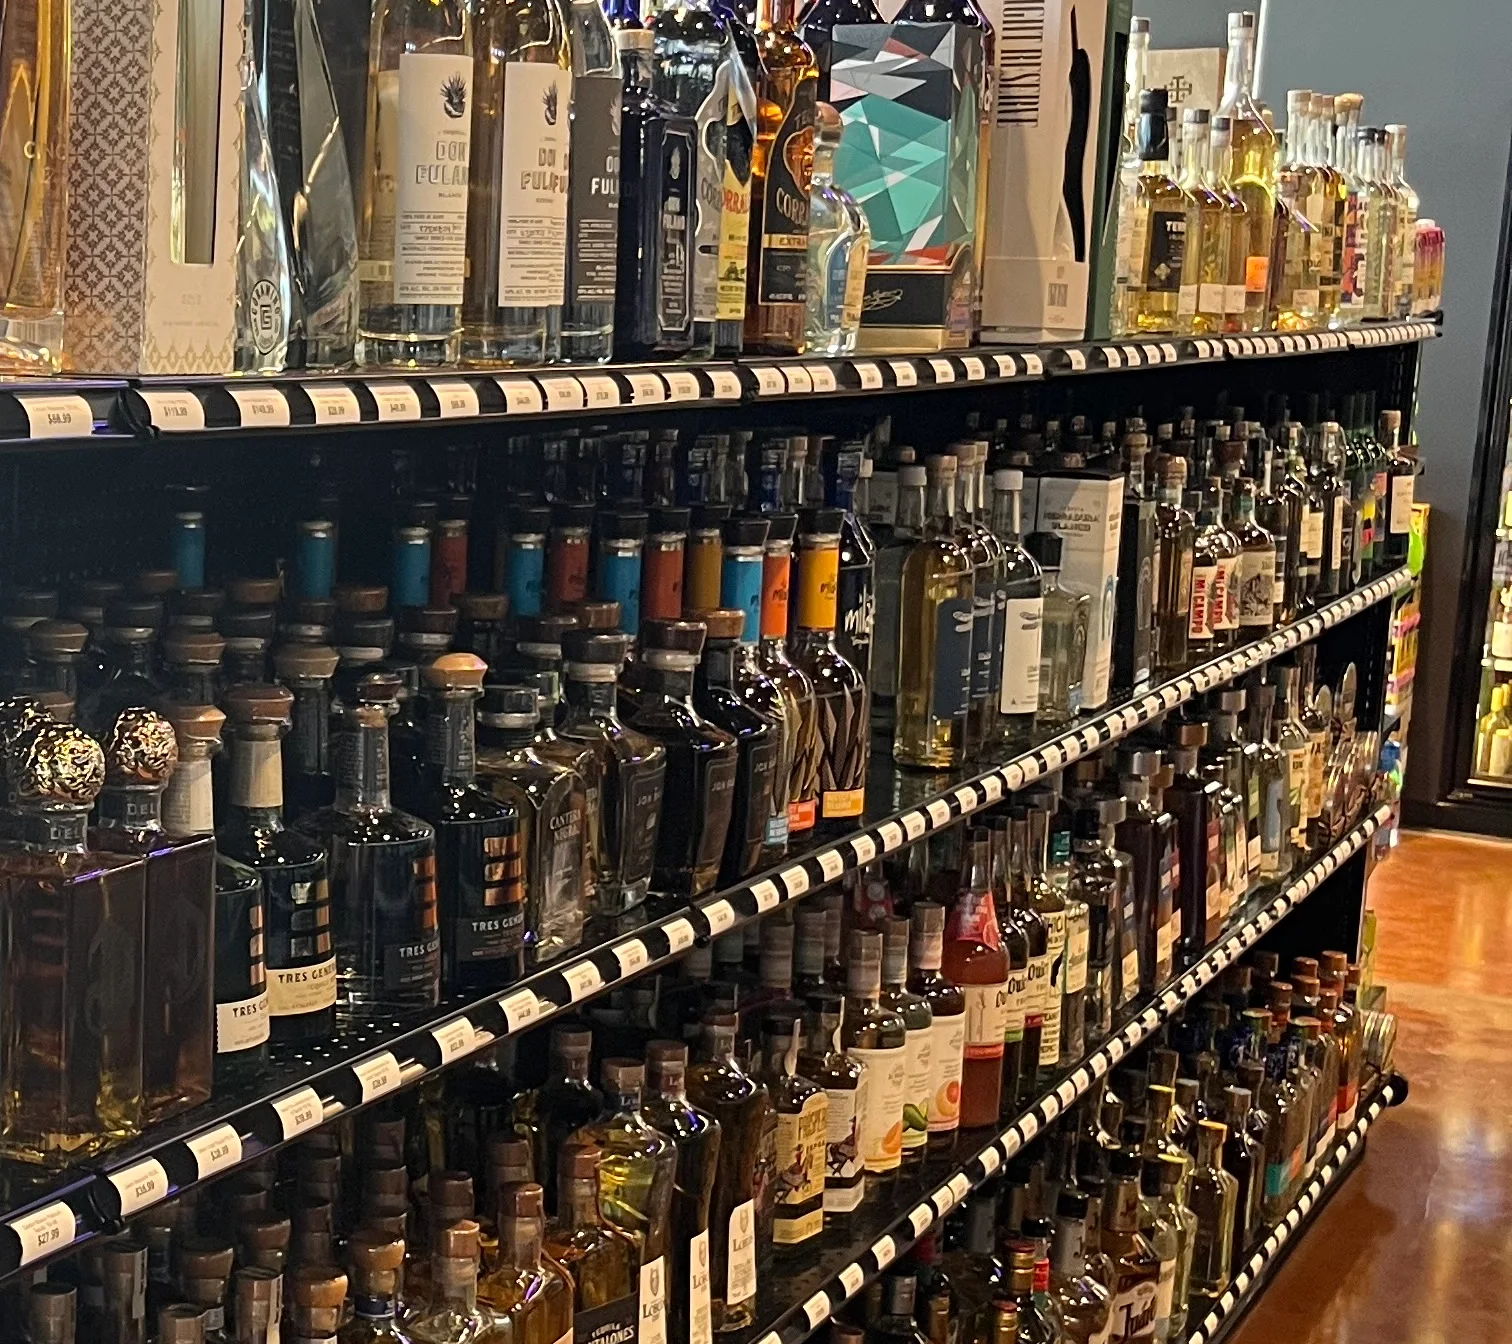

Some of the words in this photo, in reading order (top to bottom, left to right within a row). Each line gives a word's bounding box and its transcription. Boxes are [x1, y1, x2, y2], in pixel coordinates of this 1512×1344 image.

[996, 48, 1043, 129] RESERVE
[471, 920, 500, 933] TRES
[399, 944, 426, 958] TRES
[277, 970, 308, 984] TRES
[232, 1003, 259, 1019] TRES
